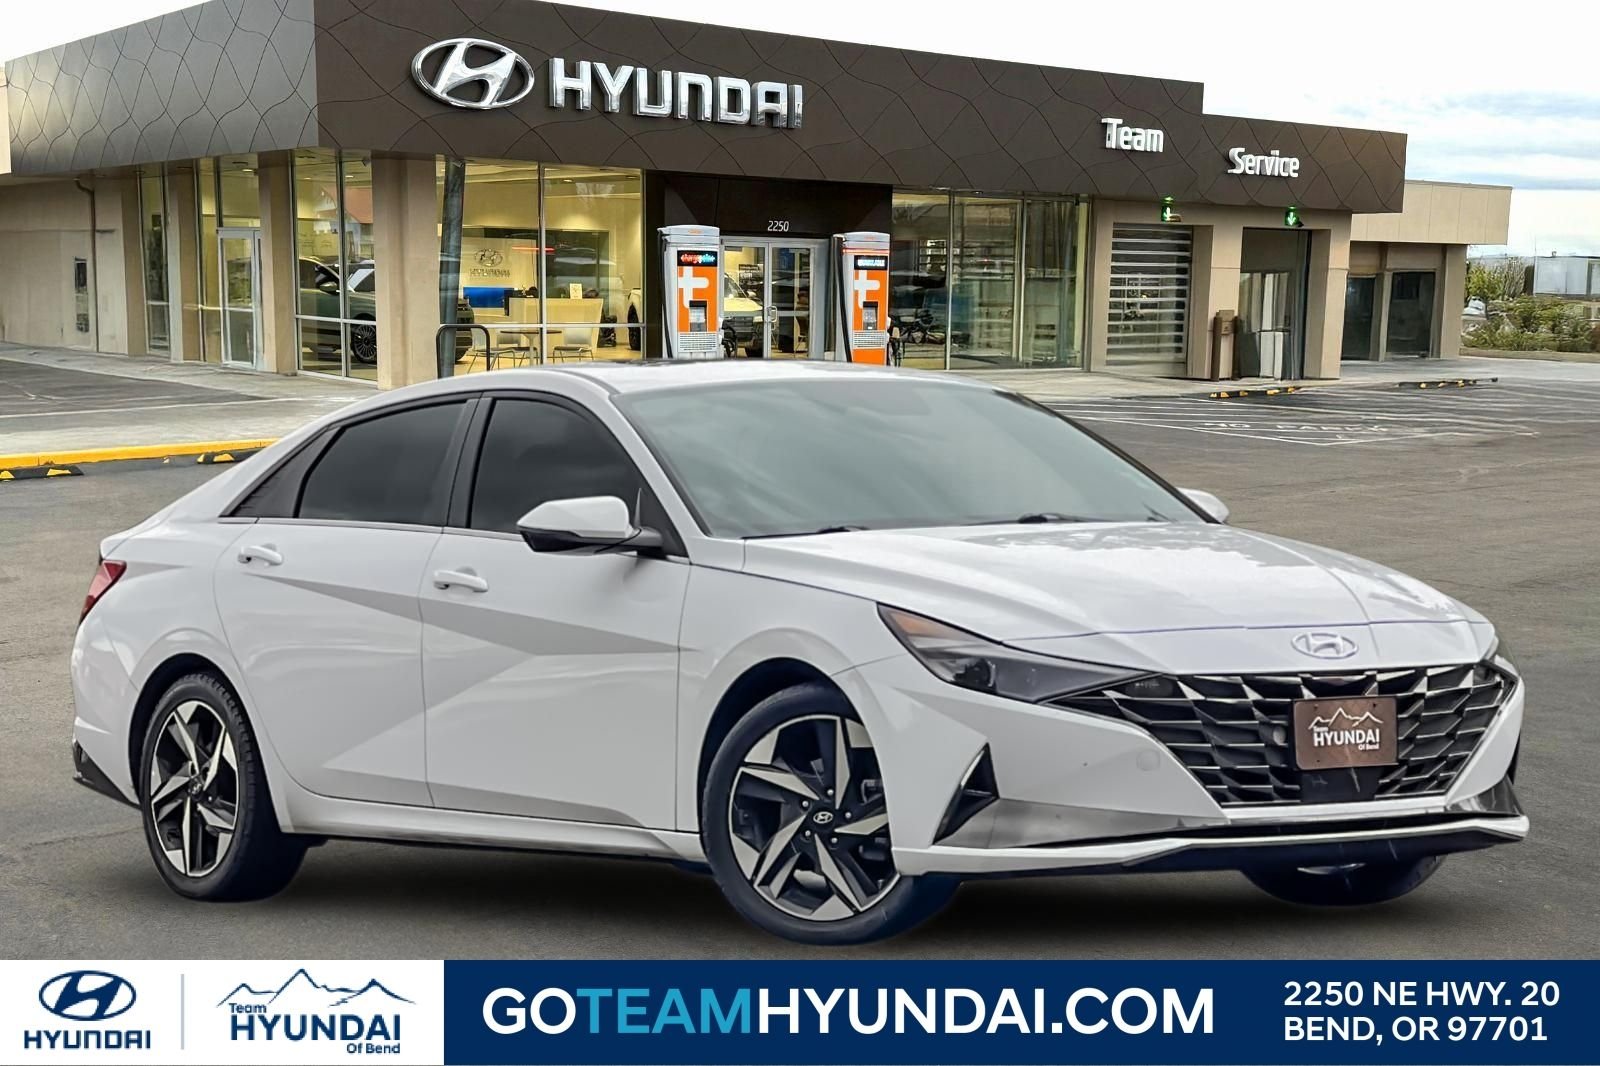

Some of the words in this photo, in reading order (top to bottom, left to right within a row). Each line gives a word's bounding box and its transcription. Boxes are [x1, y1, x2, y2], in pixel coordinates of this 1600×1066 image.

[549, 57, 803, 129] HYUNDAI
[1101, 117, 1164, 153] Team
[1227, 147, 1300, 178] Service
[767, 220, 790, 232] 2250
[1313, 728, 1379, 747] HYUNDAI
